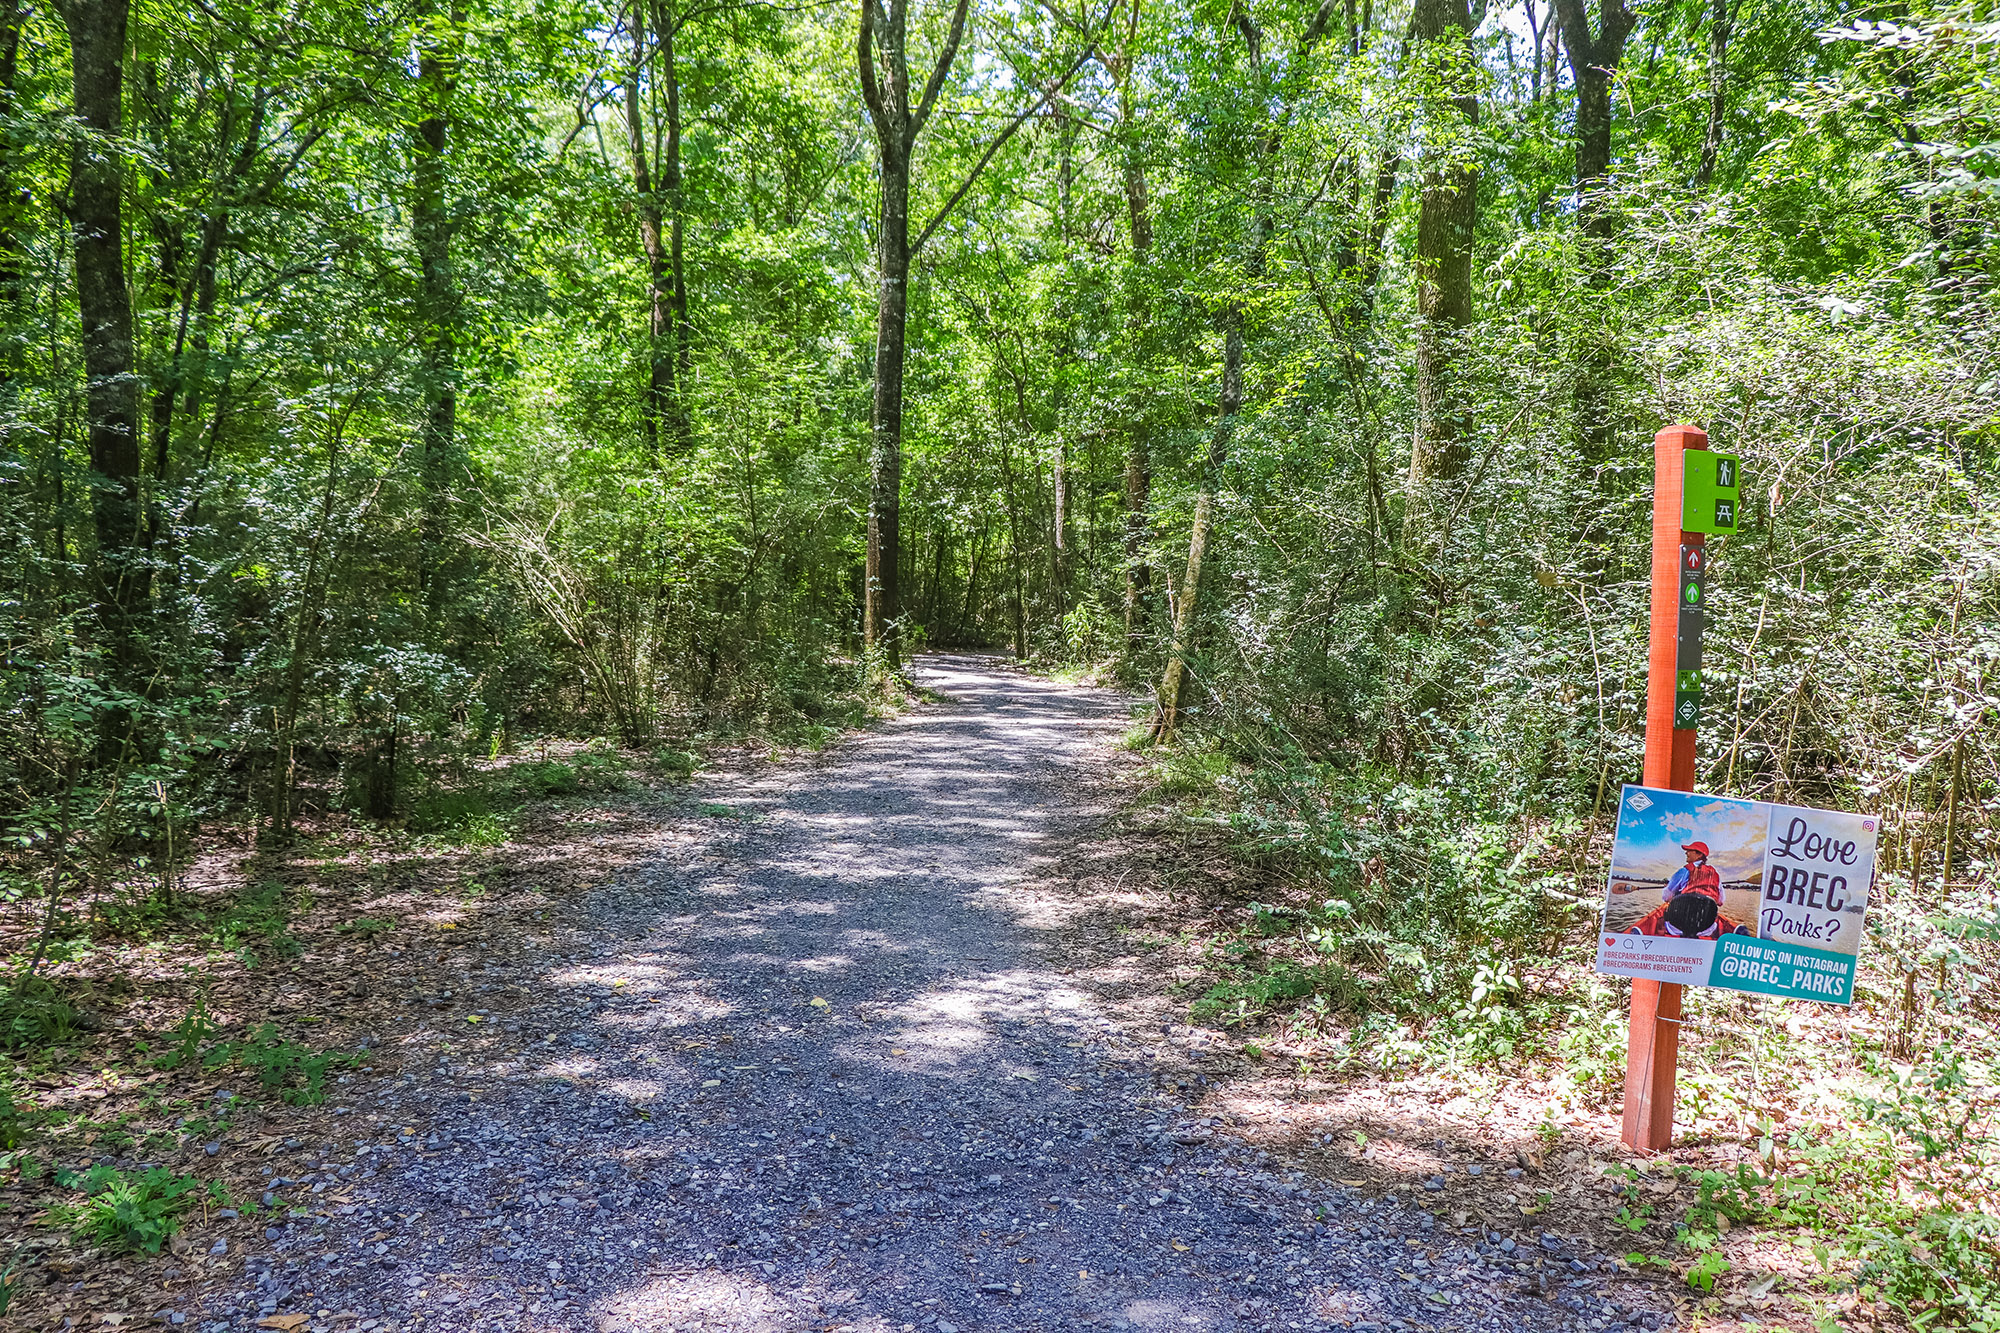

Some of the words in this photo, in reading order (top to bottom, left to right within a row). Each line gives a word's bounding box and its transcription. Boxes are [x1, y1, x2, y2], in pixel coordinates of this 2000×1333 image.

[1771, 817, 1858, 865] Love
[1766, 864, 1847, 912] BREC
[1761, 908, 1841, 942] Parks?
[1603, 960, 1652, 970] #BRECPROGRAMS
[1652, 963, 1693, 974] #BRECEVENTS
[1604, 951, 1641, 960] #BRECPARKS
[1641, 953, 1703, 966] #BRECDEVELOPMENTS
[1723, 941, 1762, 959] FOLLOW
[1763, 948, 1777, 962] US
[1778, 951, 1792, 964] ON
[1793, 954, 1848, 975] INSTAGRAM
[1720, 956, 1845, 996] @BREC_PARKS
